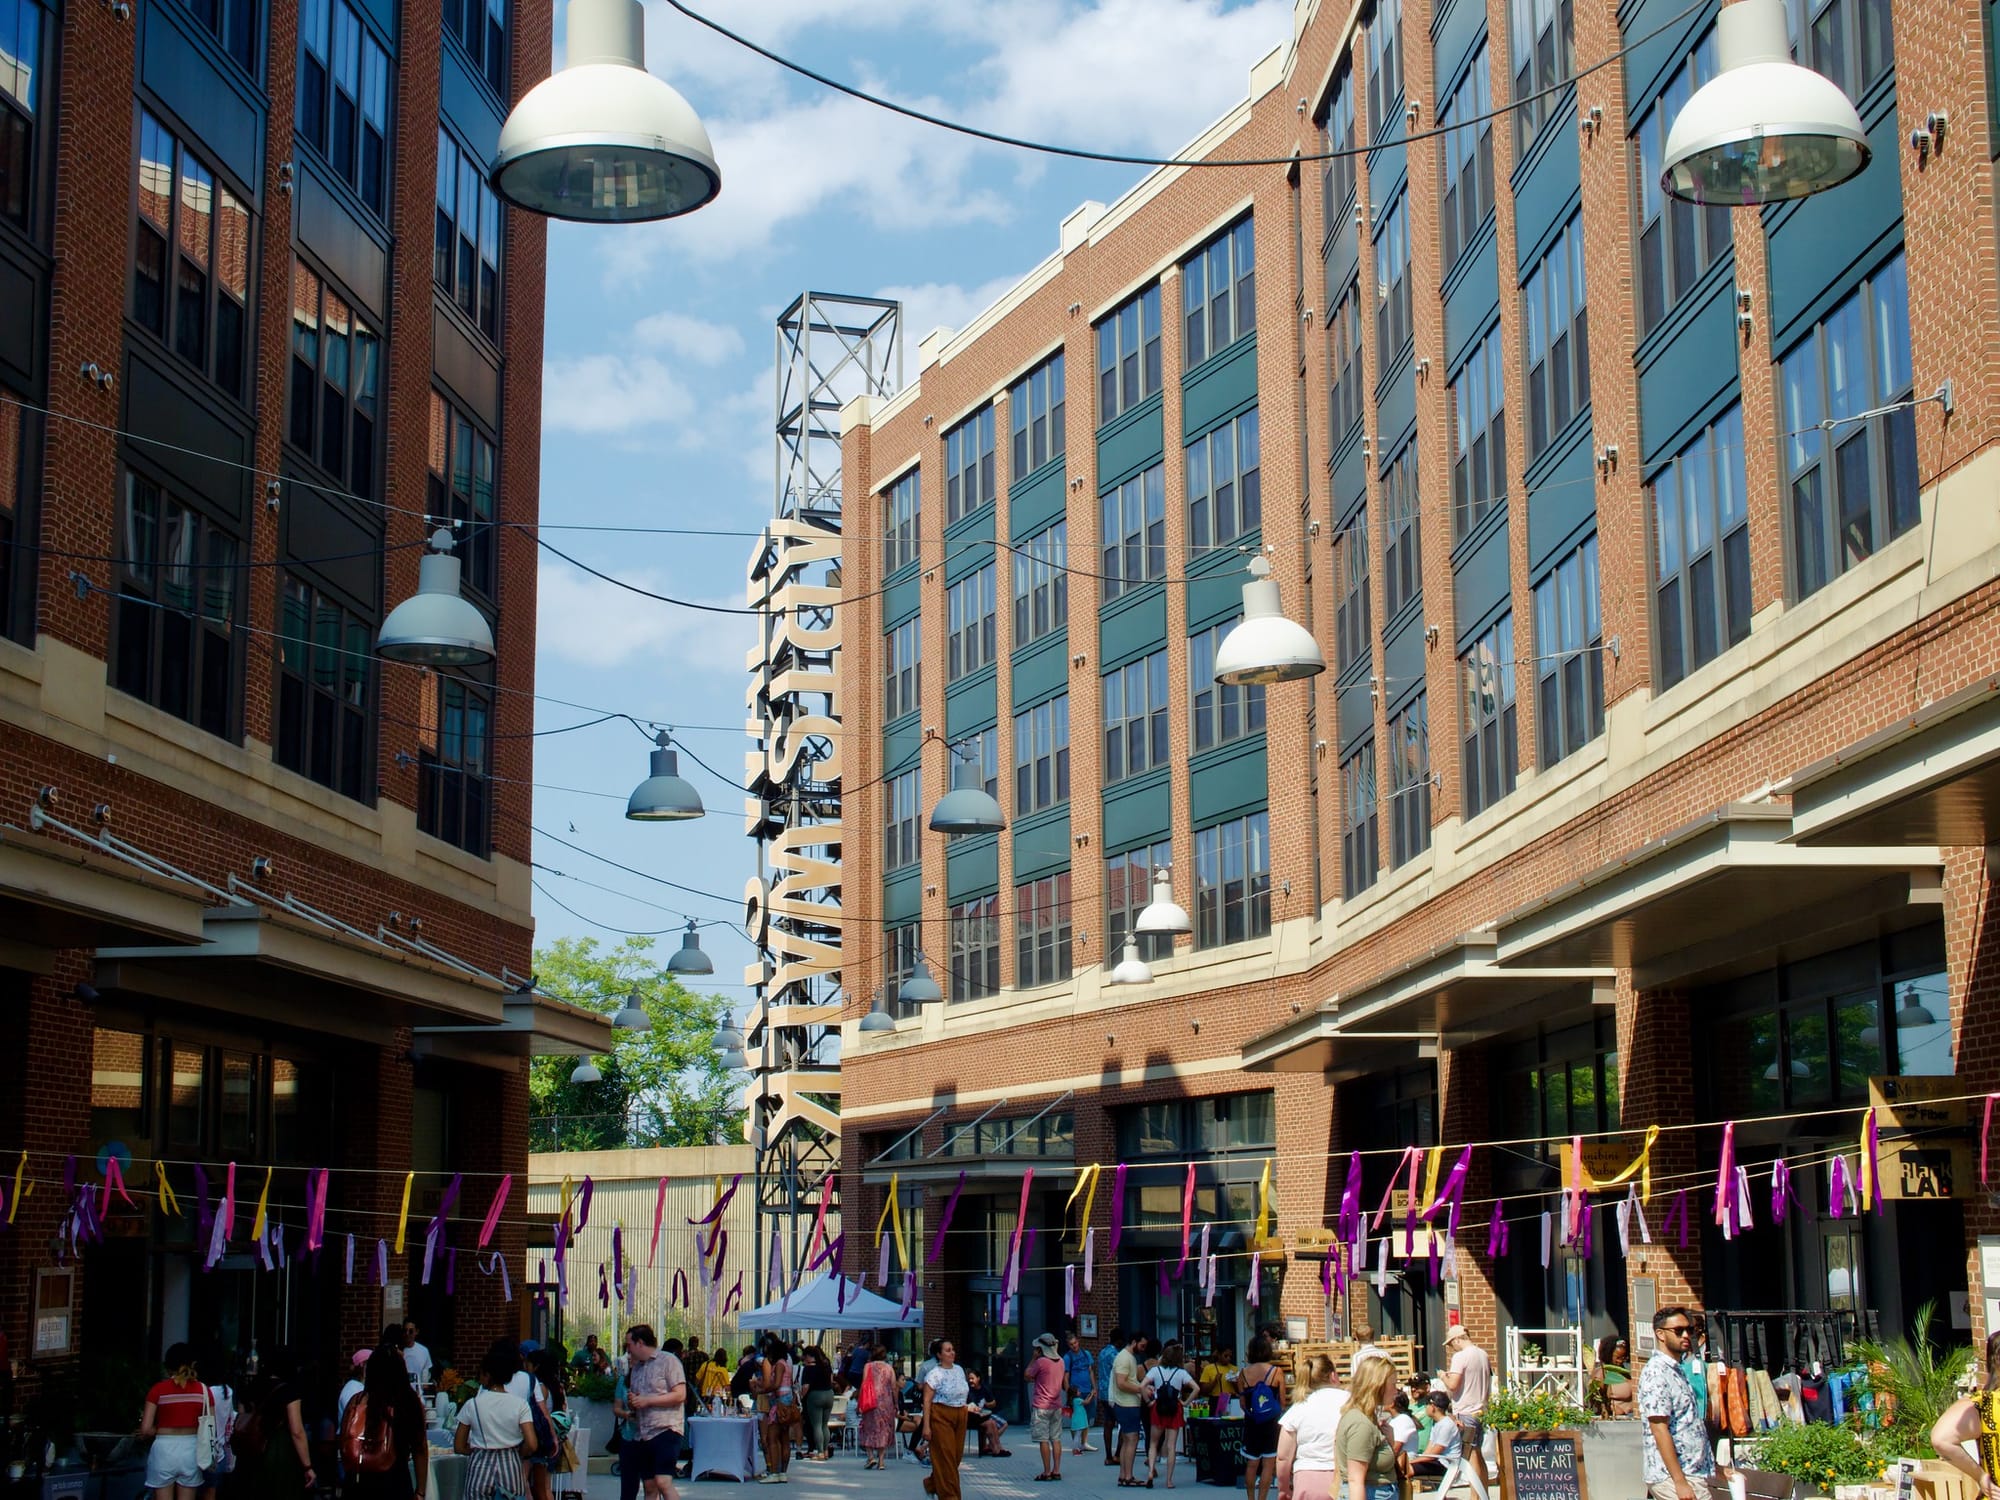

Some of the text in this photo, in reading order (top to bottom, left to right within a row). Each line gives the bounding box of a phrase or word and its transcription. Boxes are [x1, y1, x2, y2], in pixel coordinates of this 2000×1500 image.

[767, 519, 842, 1150] ARTS WALK
[1920, 1109, 1949, 1120] Fiber
[1901, 1178, 1953, 1198] LAB
[1513, 1444, 1572, 1454] DIGITAL AND
[1515, 1453, 1575, 1471] FINE ART
[1517, 1473, 1573, 1481] PAINTING
[1518, 1483, 1577, 1492] SCULPTURE
